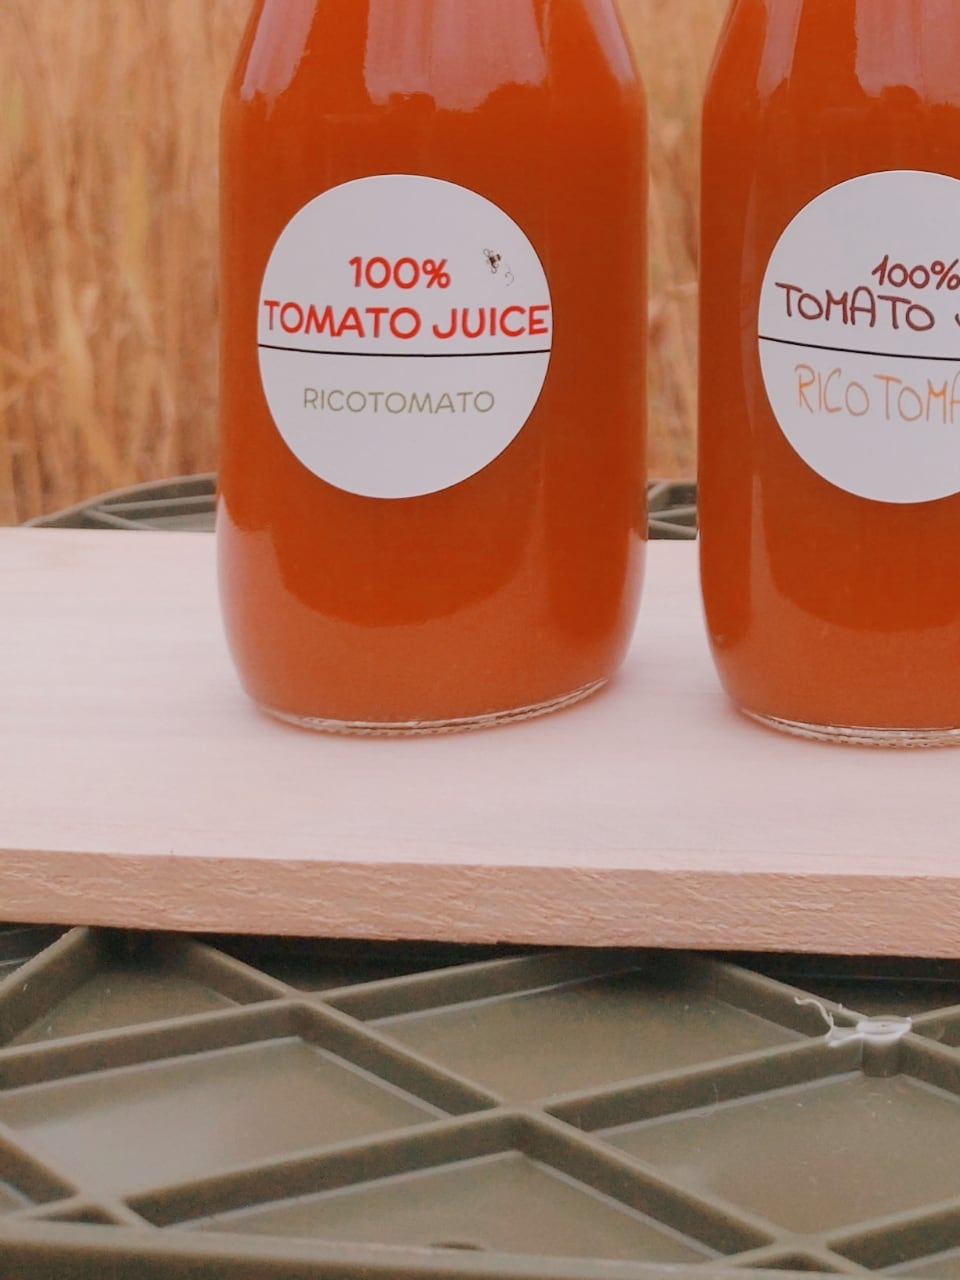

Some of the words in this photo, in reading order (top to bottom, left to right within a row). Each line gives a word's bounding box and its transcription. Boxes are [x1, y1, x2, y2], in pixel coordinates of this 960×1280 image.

[348, 256, 451, 289] 100%
[263, 299, 422, 339] TOMATO
[431, 304, 550, 339] JUICE
[774, 282, 935, 332] TOMATO
[303, 387, 495, 414] RICOTOMATO
